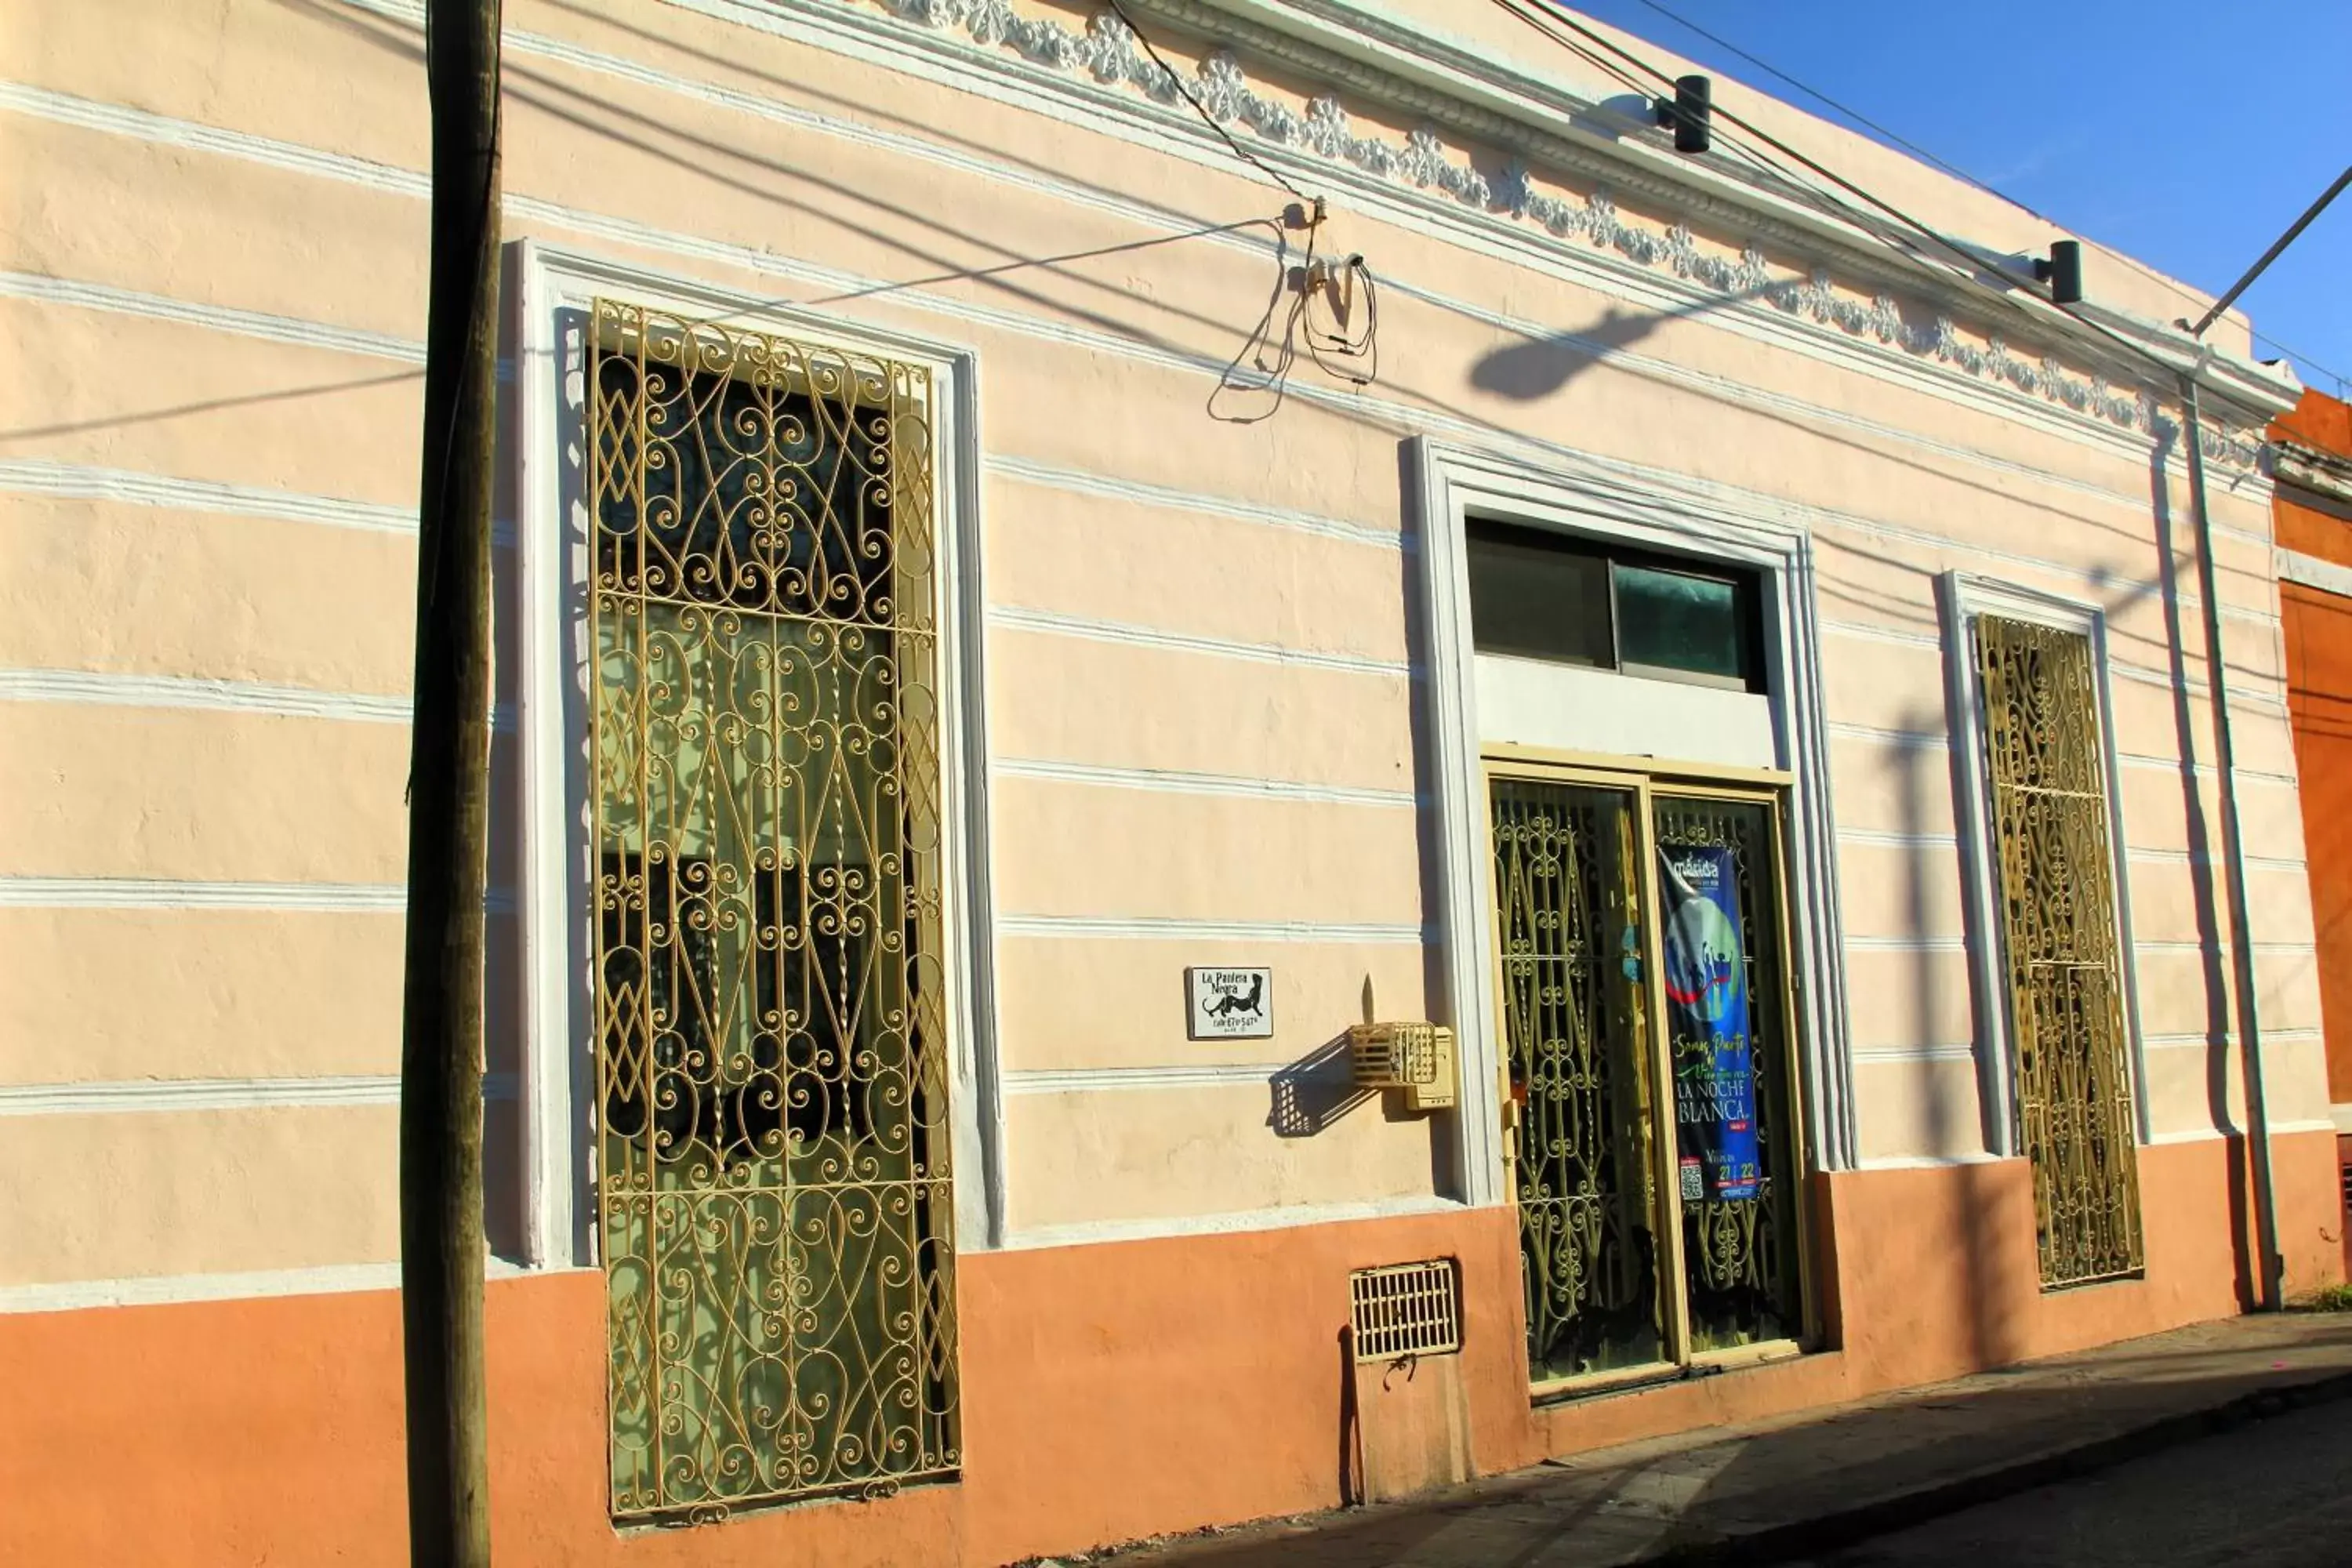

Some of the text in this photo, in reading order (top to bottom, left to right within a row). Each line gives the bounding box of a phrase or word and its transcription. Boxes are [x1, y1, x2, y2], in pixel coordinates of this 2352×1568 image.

[1216, 972, 1247, 988] Pantera
[1211, 983, 1238, 995] Negra
[1677, 1080, 1744, 1098] LA NOCHE
[1679, 1098, 1744, 1123] BLANCA
[1741, 1163, 1755, 1178] 22
